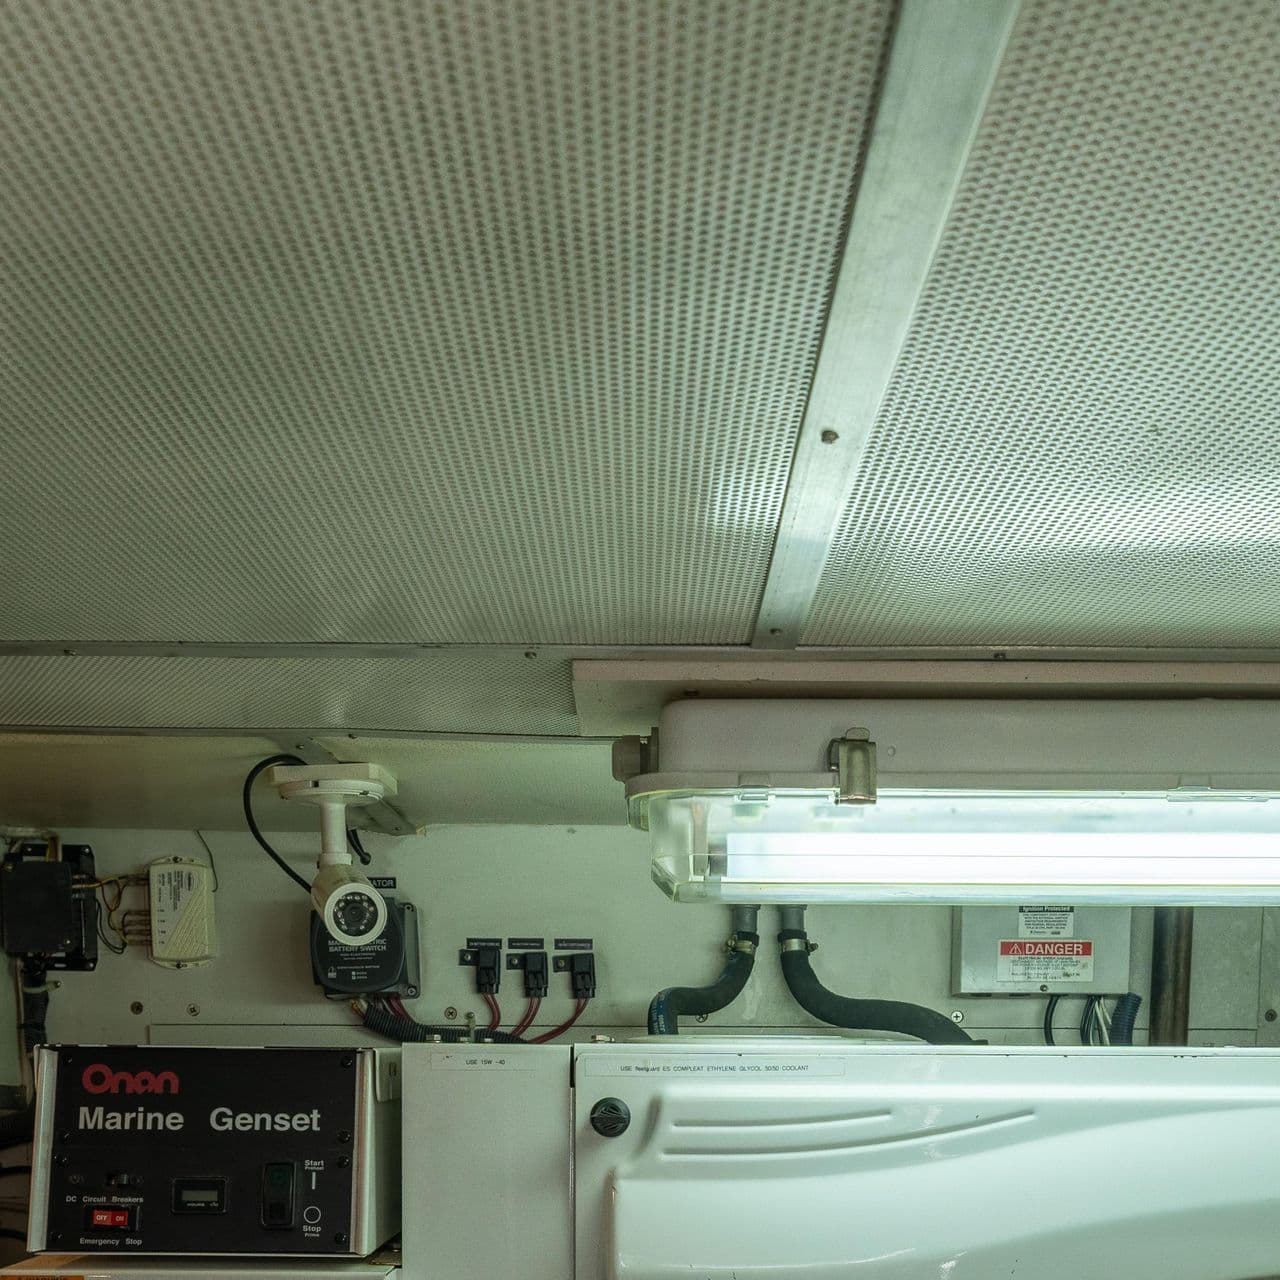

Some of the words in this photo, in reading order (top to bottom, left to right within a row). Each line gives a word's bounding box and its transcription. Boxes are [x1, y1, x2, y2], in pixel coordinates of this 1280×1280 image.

[1025, 944, 1083, 955] DANGER
[81, 1064, 180, 1094] Onan
[78, 1106, 184, 1131] Marine
[209, 1106, 321, 1132] Genset
[66, 1195, 77, 1203] DC
[83, 1195, 106, 1203] Circuit
[303, 1225, 321, 1234] Stop
[80, 1238, 120, 1247] Emergency
[126, 1238, 144, 1247] Stop
